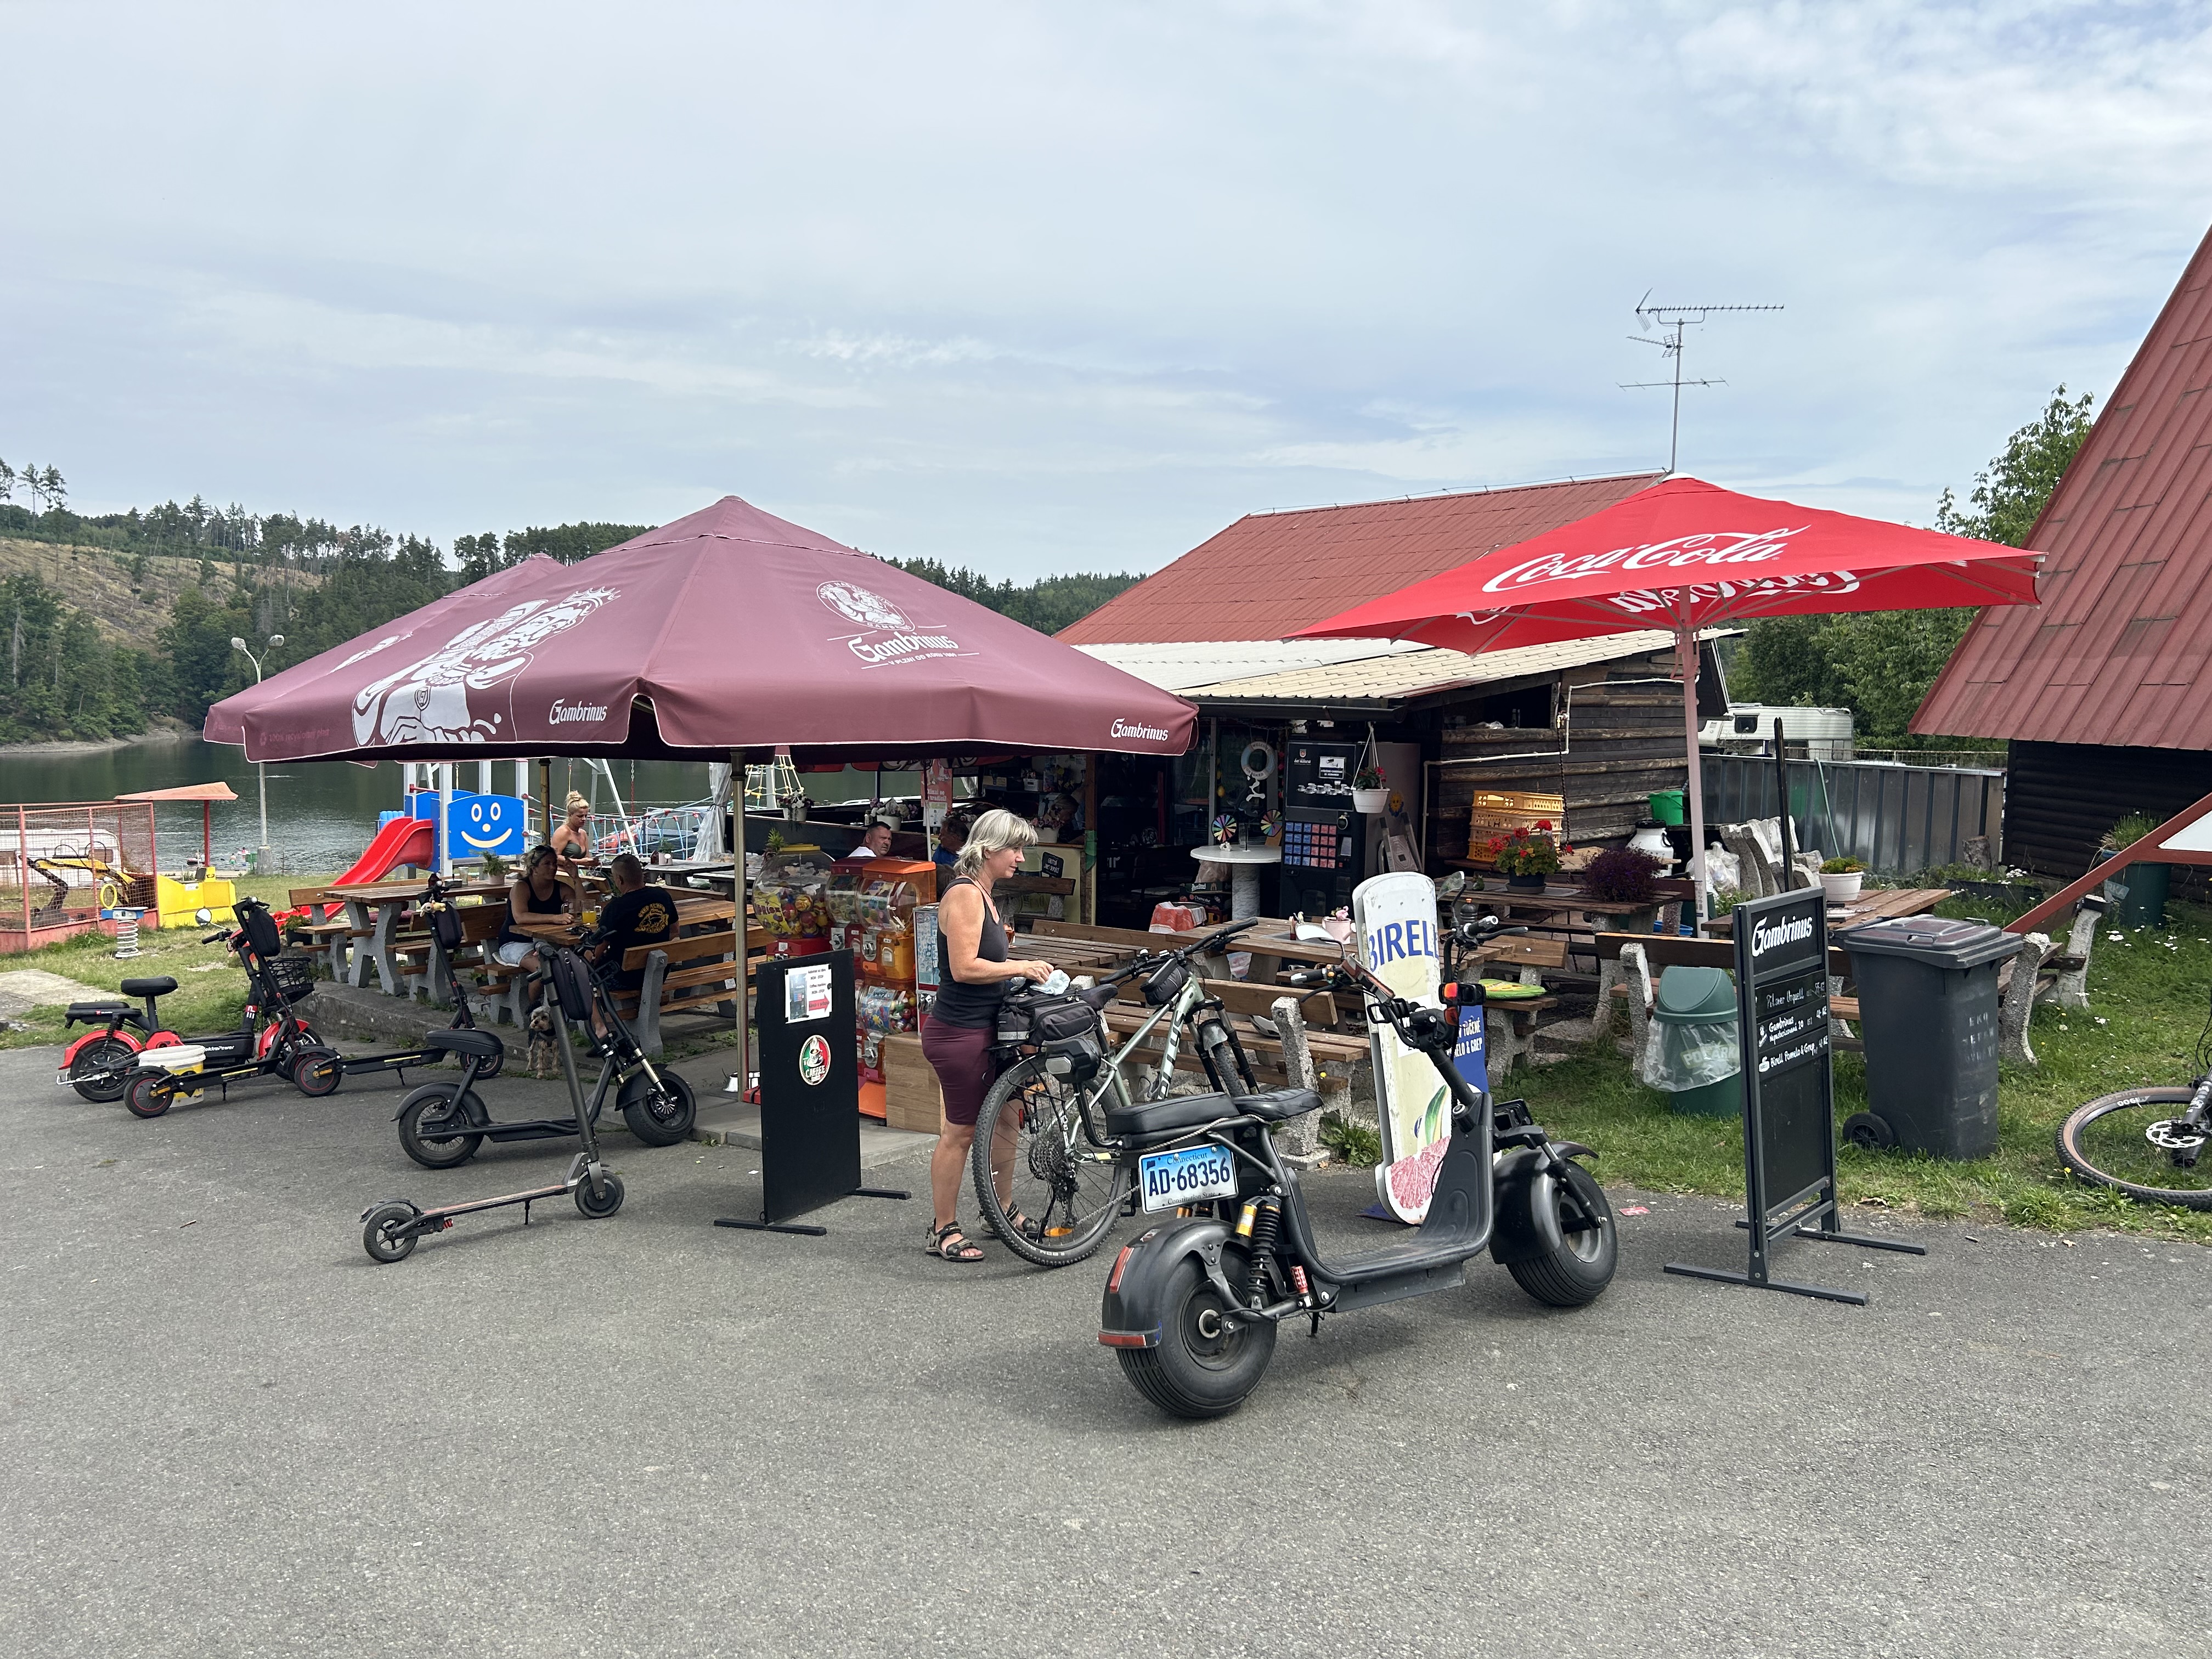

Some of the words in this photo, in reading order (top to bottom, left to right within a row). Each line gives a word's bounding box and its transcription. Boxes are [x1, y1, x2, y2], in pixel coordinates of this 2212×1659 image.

[1481, 524, 1812, 592] Coca-Cola
[848, 631, 959, 662] Gambrinus
[549, 698, 607, 725] Gambrinus
[1110, 718, 1169, 741] Gambrinus
[1369, 920, 1440, 972] BIRELL
[1752, 916, 1813, 957] Gambrinus
[1462, 1017, 1481, 1037] TOČENÉ
[1769, 1016, 1794, 1032] Gambrinus
[1466, 1041, 1471, 1053] &
[1470, 1037, 1483, 1052] GREP
[805, 1064, 825, 1078] CAFFEE
[1166, 1153, 1208, 1165] Connecticut
[1167, 1194, 1201, 1205] Constitution
